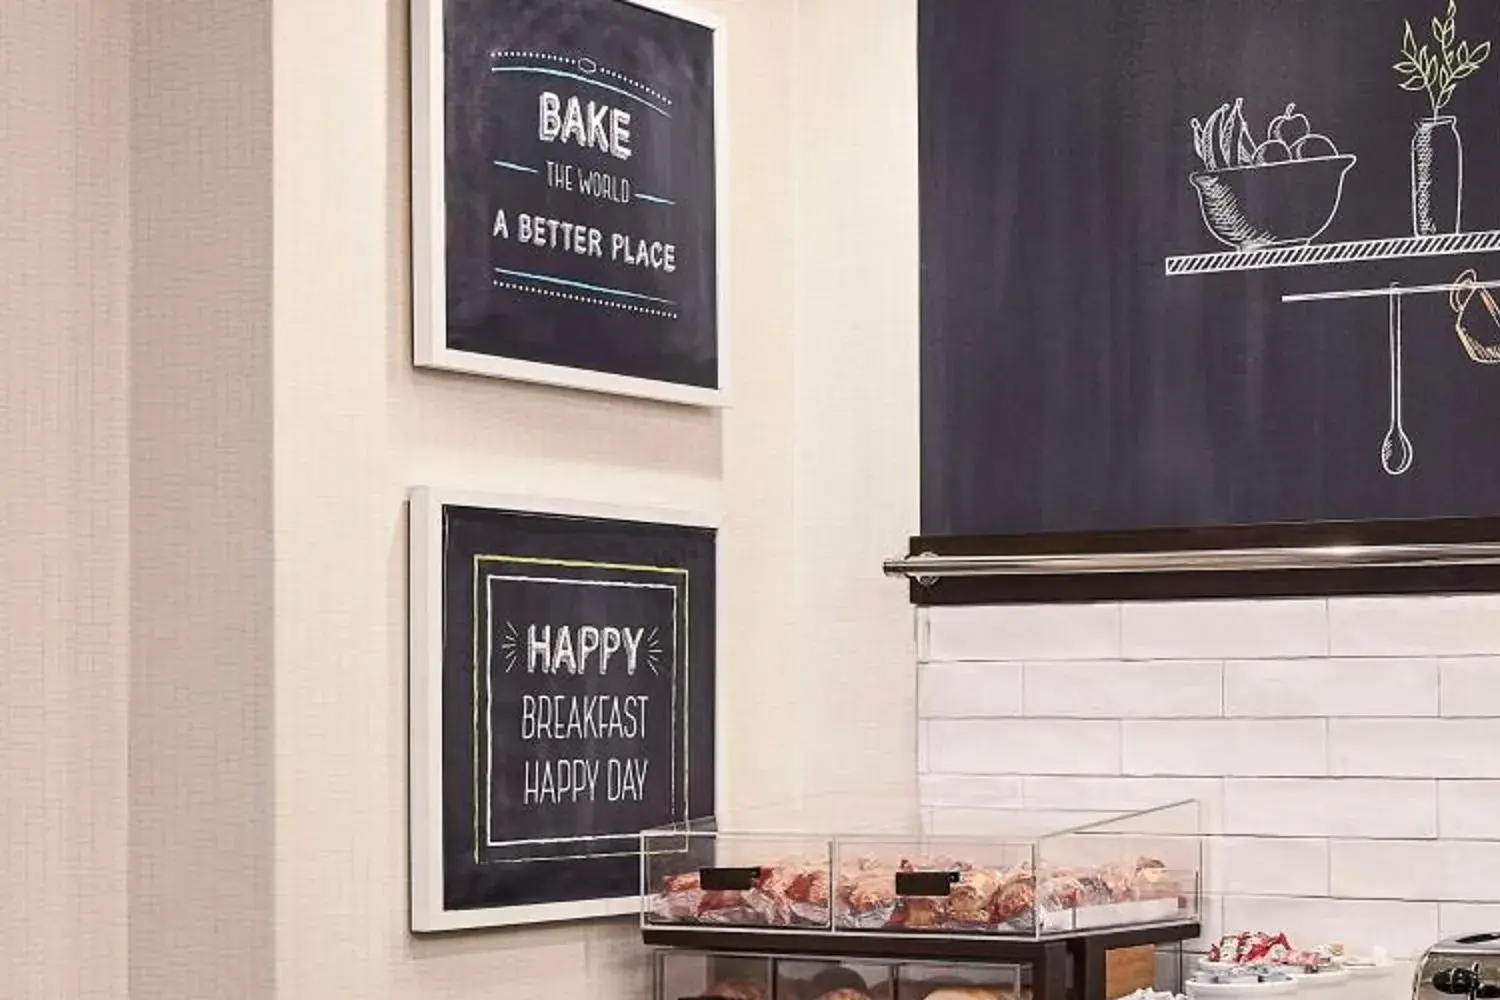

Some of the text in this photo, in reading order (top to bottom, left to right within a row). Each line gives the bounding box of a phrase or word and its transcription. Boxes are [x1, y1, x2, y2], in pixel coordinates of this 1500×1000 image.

[538, 90, 632, 160] BAKE
[545, 160, 630, 203] THE WORLD
[492, 209, 676, 274] A BETTER PLACE
[527, 623, 646, 675] HAPPY
[521, 694, 649, 740] BREAKFAST
[524, 758, 649, 804] HAPPY DAY
